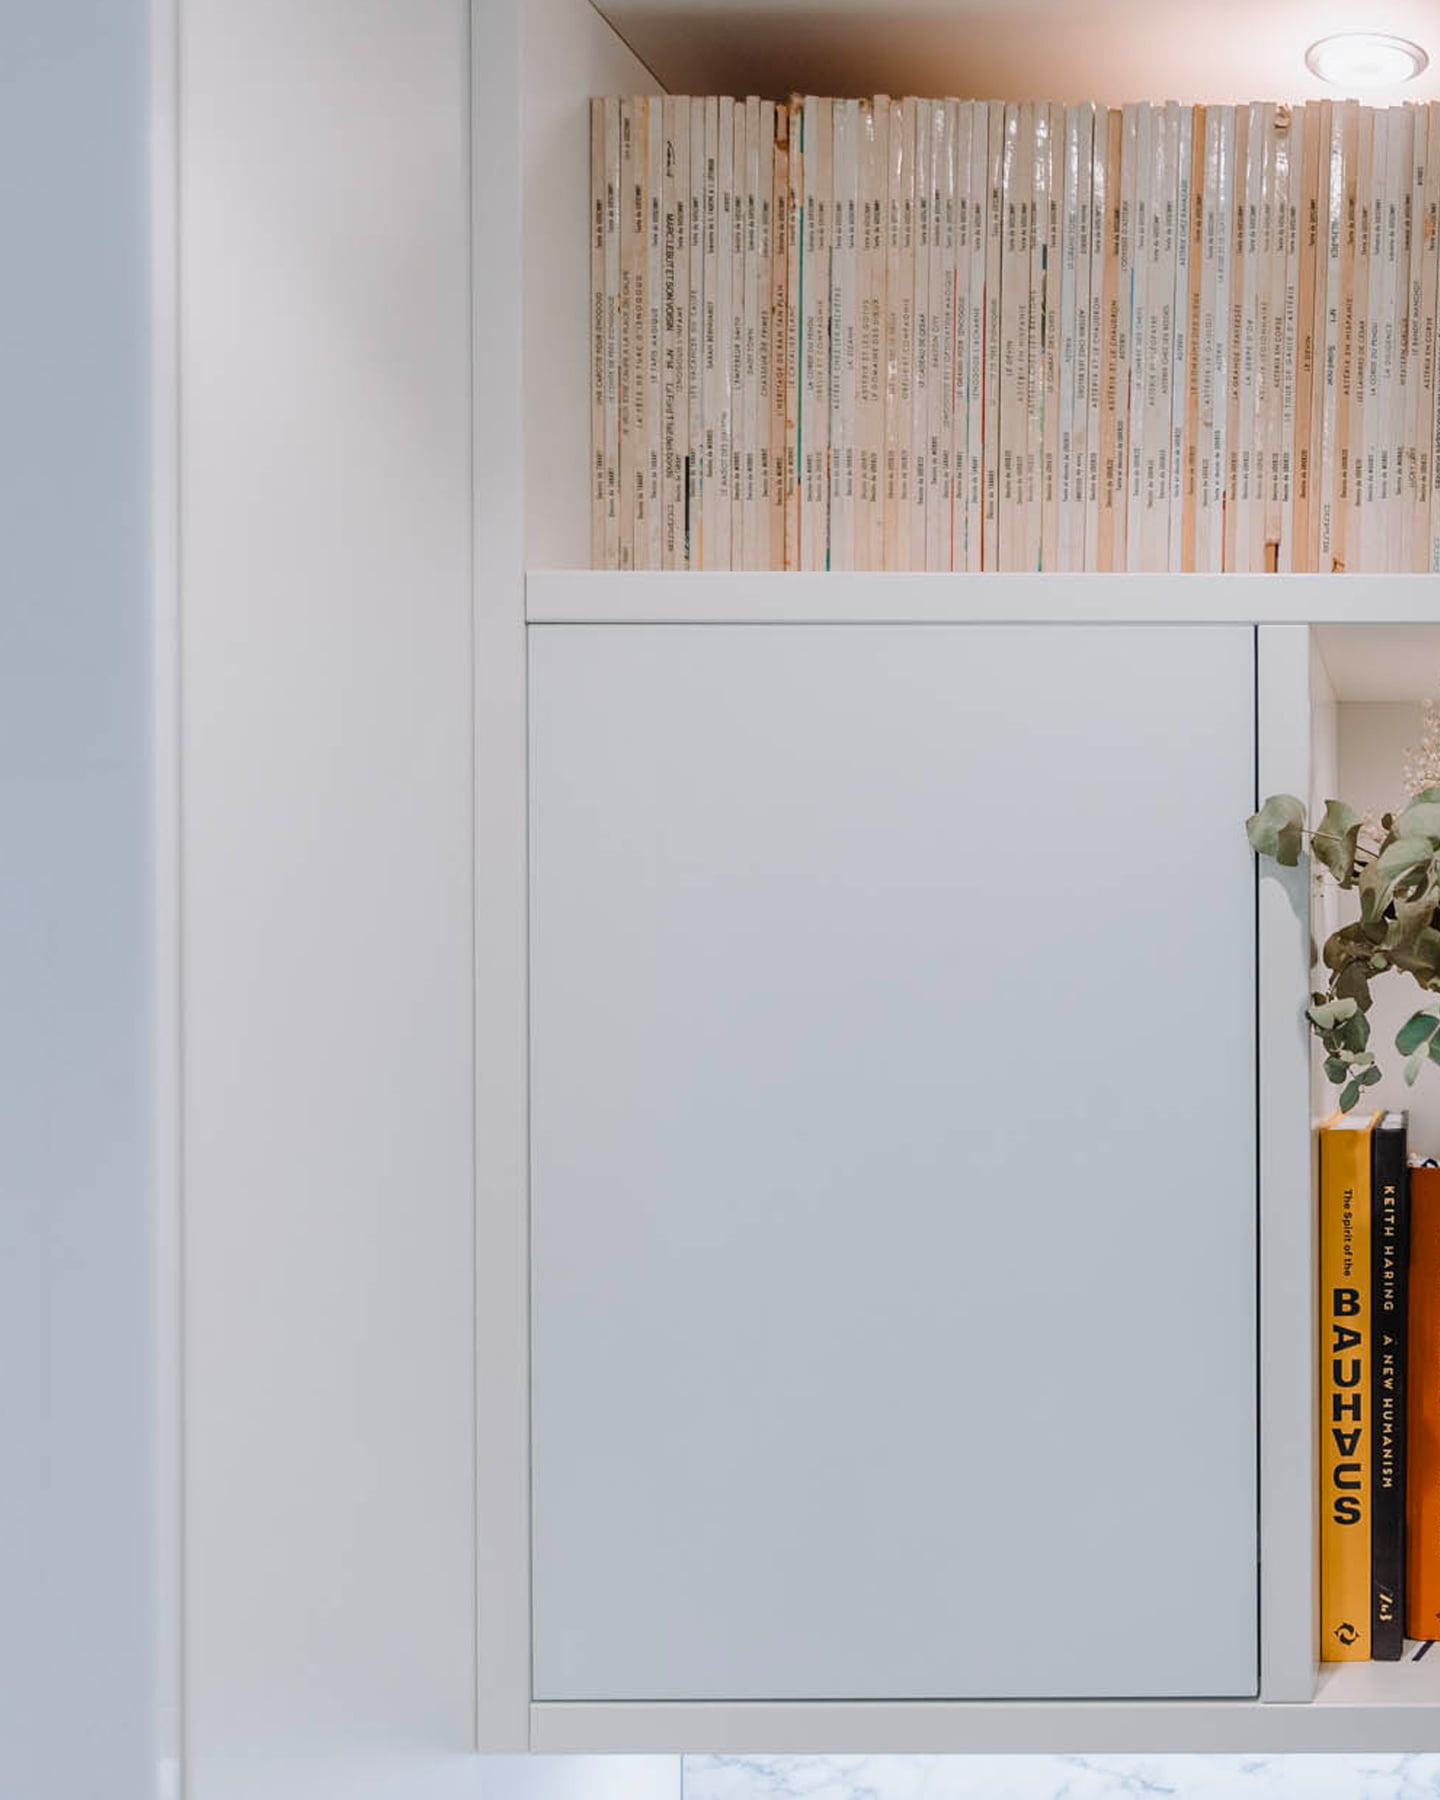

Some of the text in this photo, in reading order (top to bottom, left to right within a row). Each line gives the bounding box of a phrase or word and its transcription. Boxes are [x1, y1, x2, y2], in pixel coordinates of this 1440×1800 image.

[1342, 1188, 1353, 1277] The Spirit of the
[1382, 1185, 1395, 1488] KEITH HARING A NEW HUMANISM
[1332, 1287, 1362, 1526] BAUHAUS
